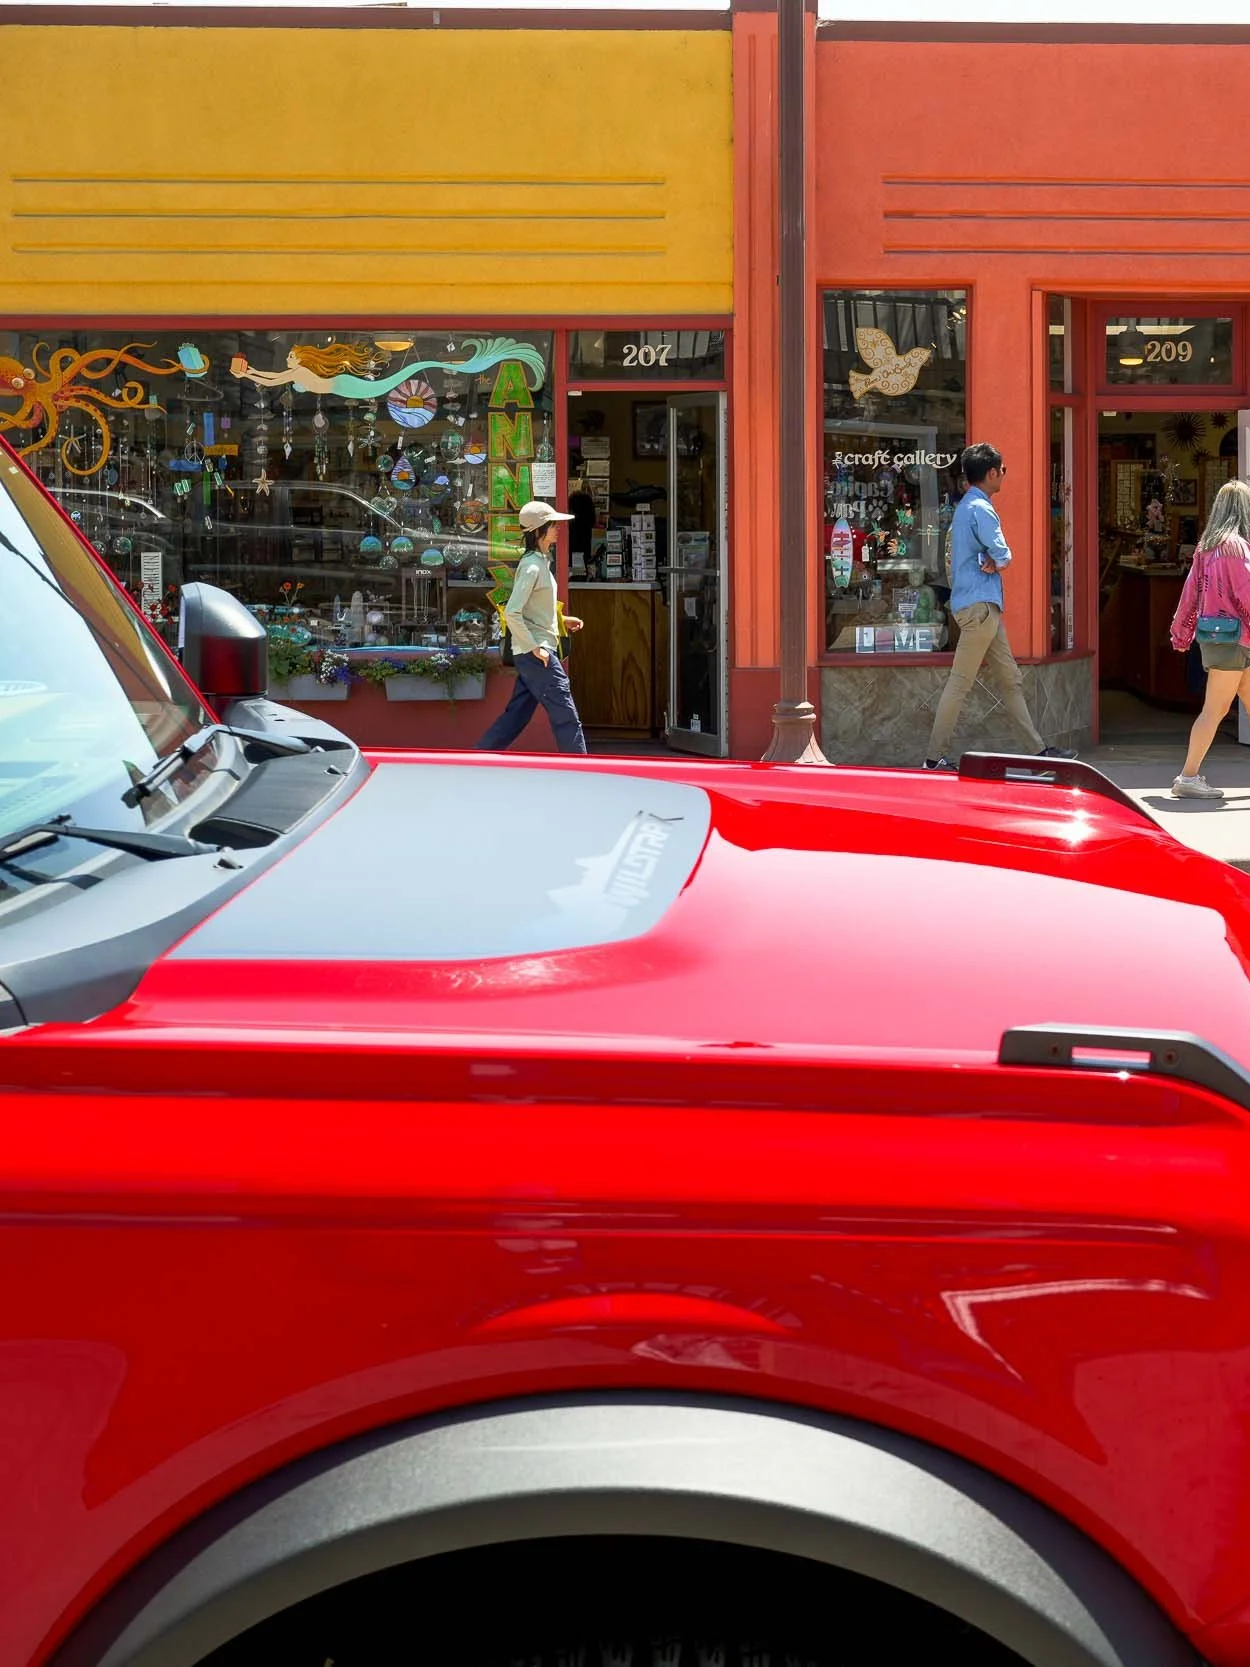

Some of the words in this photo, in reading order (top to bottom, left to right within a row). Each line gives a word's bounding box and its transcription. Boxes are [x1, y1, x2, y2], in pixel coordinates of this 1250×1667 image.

[622, 344, 672, 367] 207
[1146, 340, 1193, 362] 209
[475, 374, 491, 385] the
[832, 451, 843, 469] the
[844, 449, 892, 470] craft
[893, 449, 958, 469] gallery
